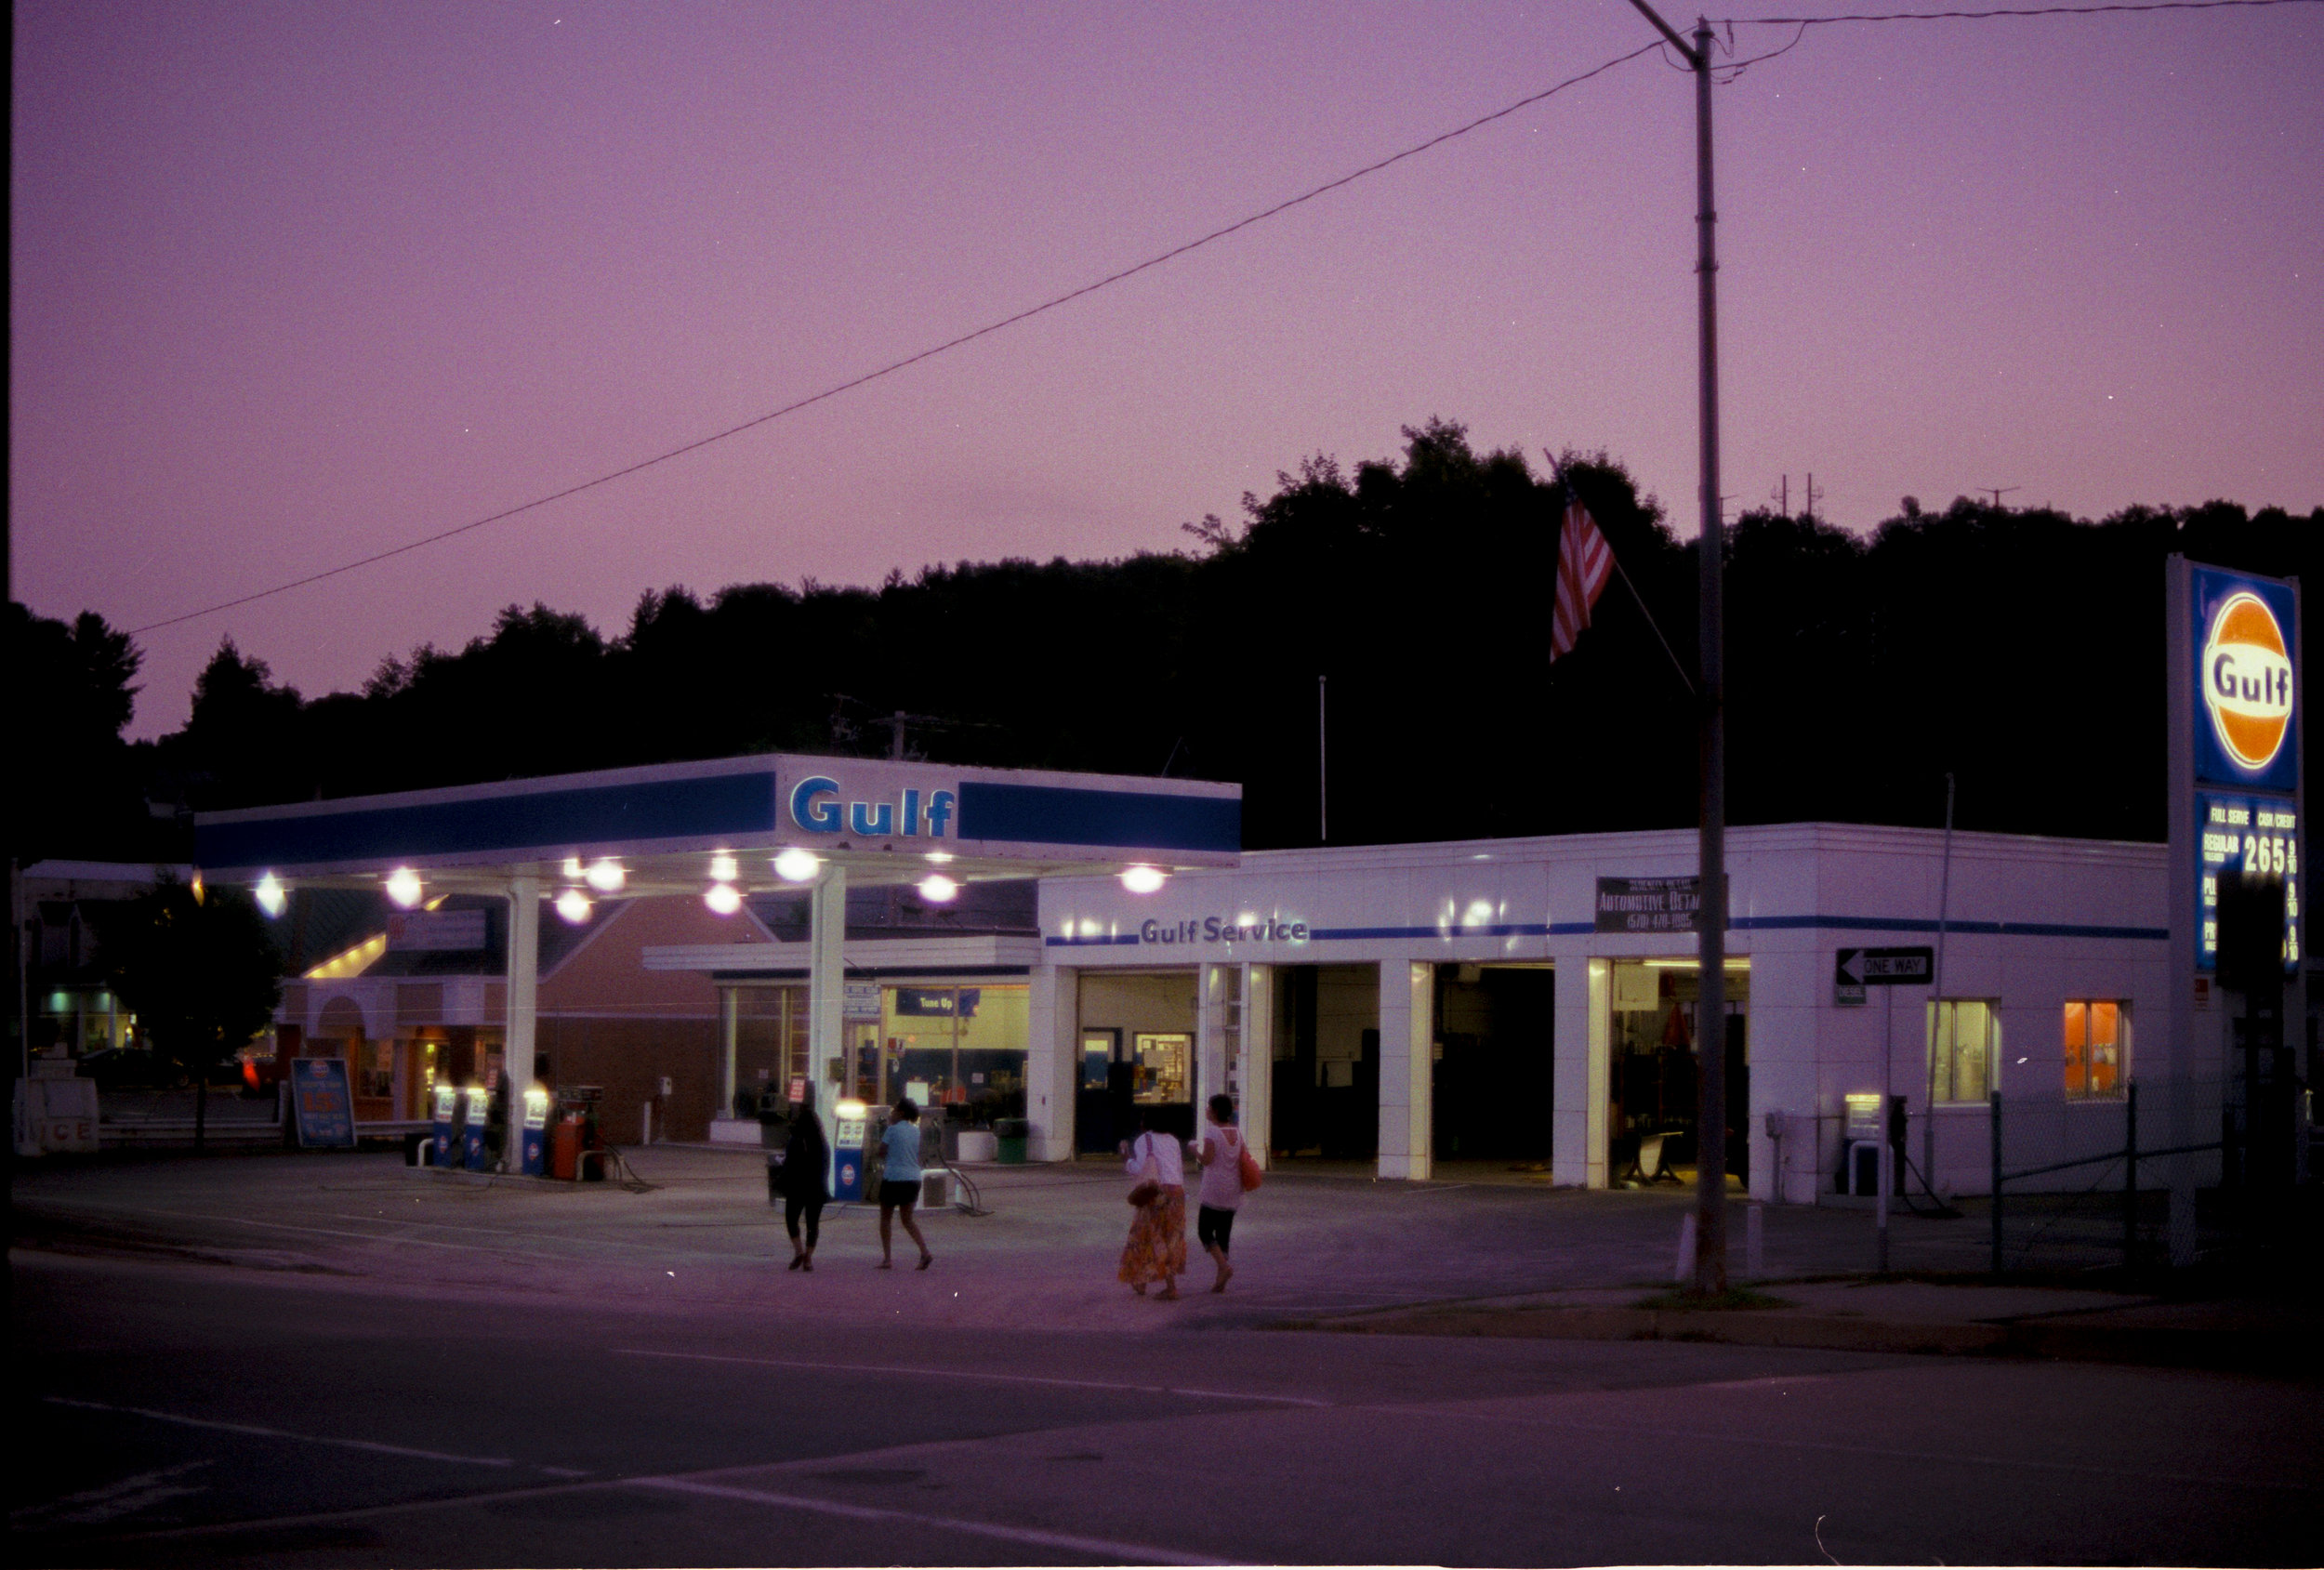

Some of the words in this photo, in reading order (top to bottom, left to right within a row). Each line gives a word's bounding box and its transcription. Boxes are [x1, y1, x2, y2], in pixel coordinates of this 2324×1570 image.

[2213, 653, 2289, 706] Gulf
[790, 775, 955, 837] Gulf
[2211, 808, 2226, 823] FULL
[2228, 809, 2250, 825] SERVE
[2203, 833, 2239, 853] REGULAR
[2244, 836, 2285, 874] 265
[1599, 891, 1665, 911] AUTOMOTIVE
[1141, 918, 1198, 943] Gulf
[1203, 916, 1308, 943] Service
[1865, 958, 1890, 973] ONE
[1894, 957, 1921, 973] WAY
[919, 997, 939, 1008] Tune
[941, 997, 953, 1009] Up
